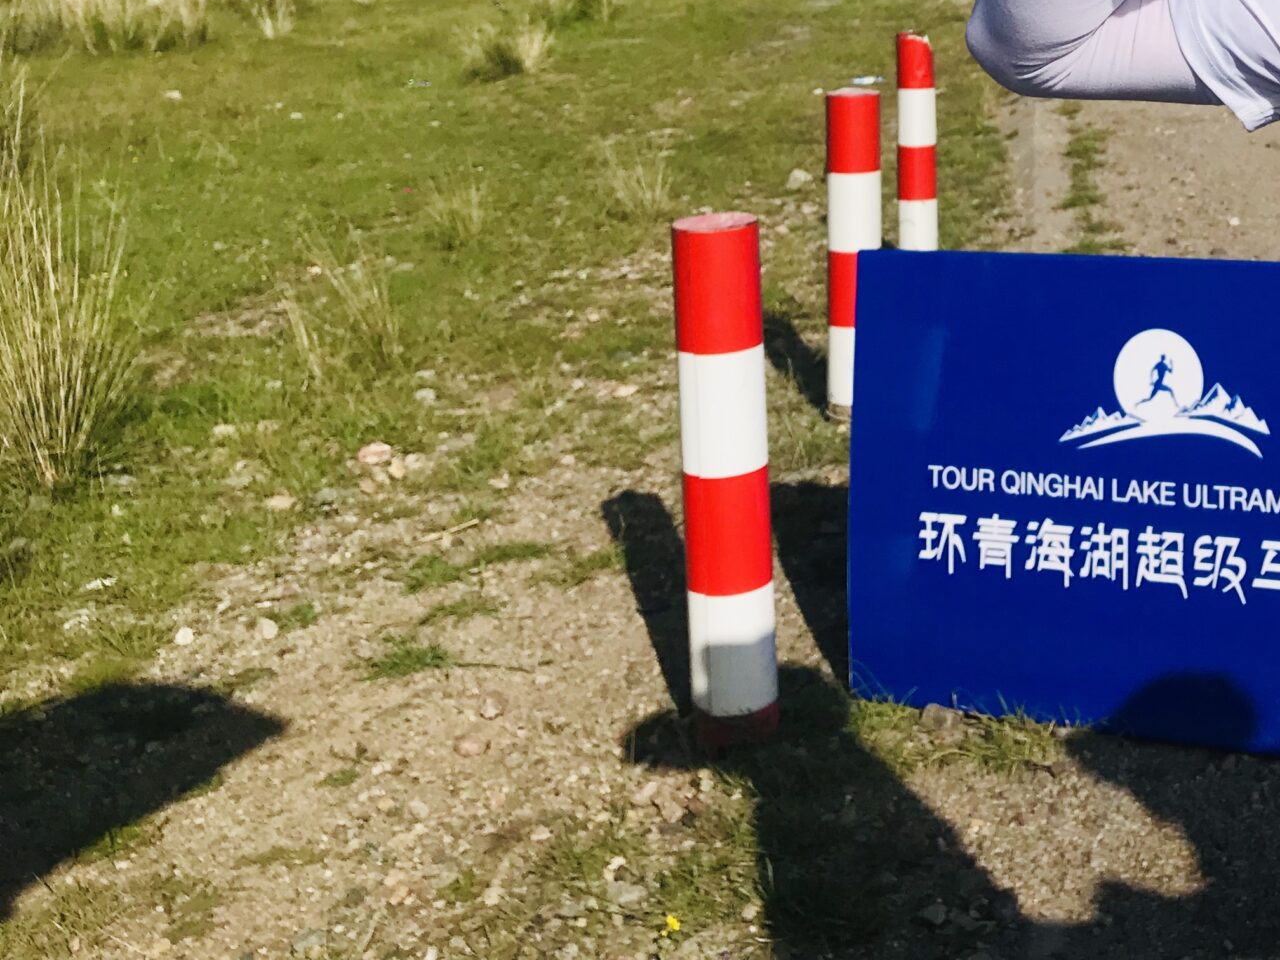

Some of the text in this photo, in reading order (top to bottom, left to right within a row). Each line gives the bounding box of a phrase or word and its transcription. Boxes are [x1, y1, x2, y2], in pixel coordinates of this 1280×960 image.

[927, 464, 995, 493] TOUR
[1000, 469, 1105, 501] QINGHAI
[1111, 477, 1177, 506] LAKE
